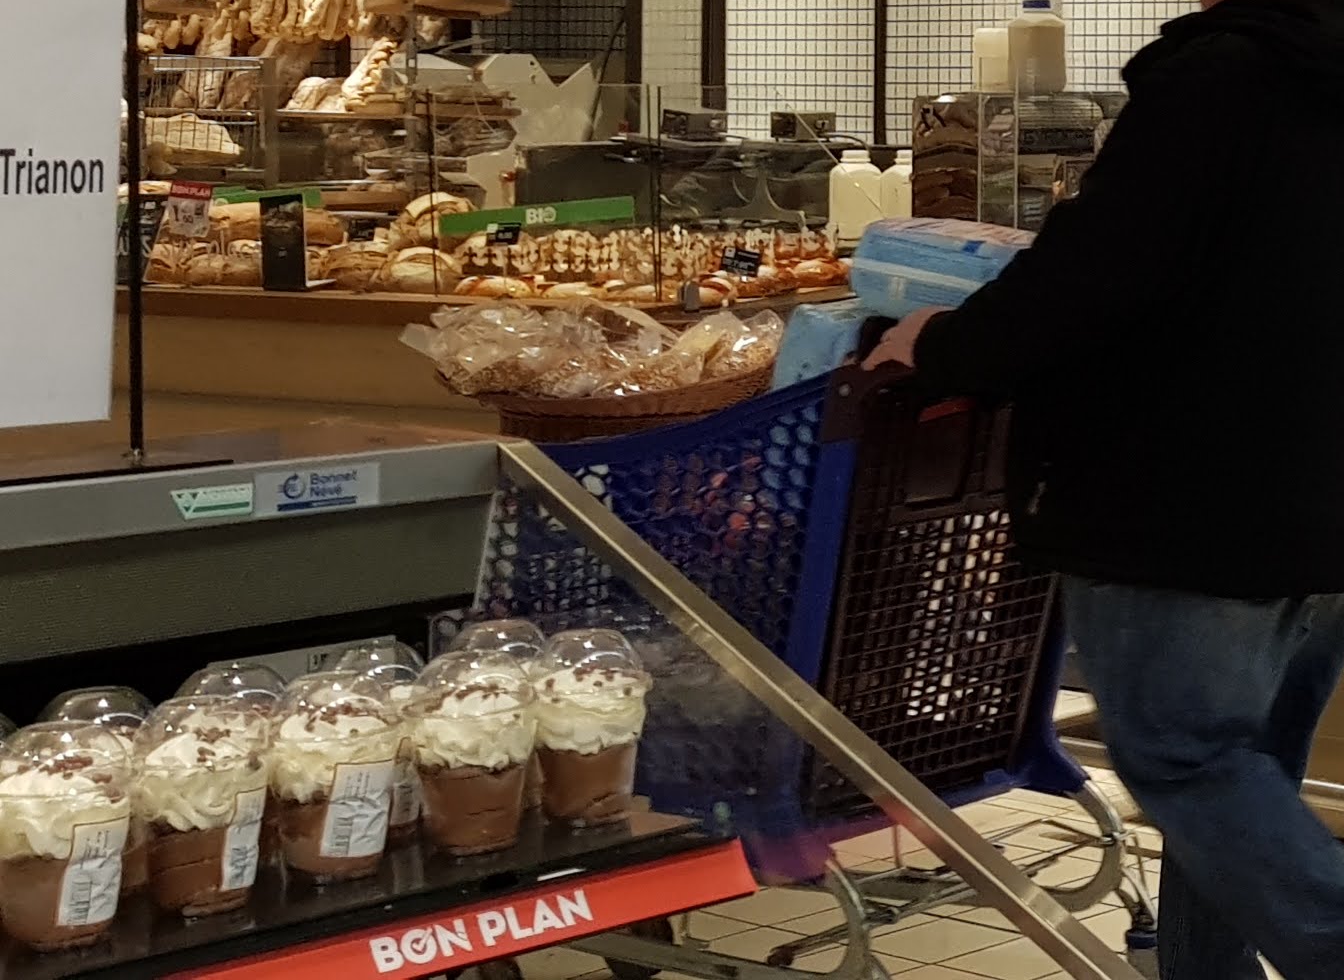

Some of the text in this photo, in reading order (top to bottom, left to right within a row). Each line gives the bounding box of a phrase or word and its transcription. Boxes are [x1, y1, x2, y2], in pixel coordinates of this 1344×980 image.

[0, 148, 104, 195] Trianon
[368, 889, 593, 973] BON PLAN
